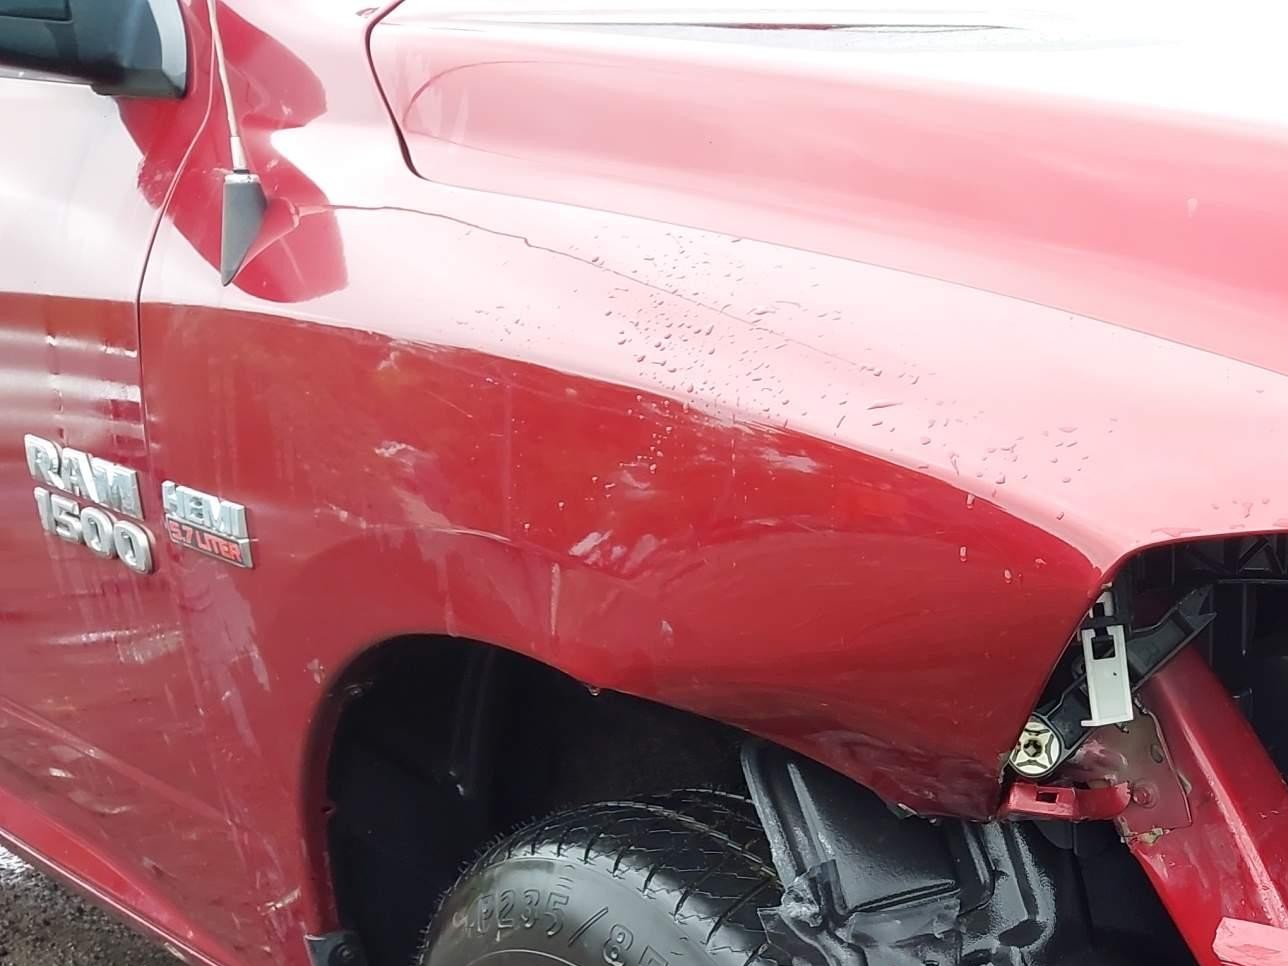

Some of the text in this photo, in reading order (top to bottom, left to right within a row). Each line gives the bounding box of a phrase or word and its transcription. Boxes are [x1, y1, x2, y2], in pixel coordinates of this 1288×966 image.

[24, 433, 145, 521] RAM
[161, 480, 248, 539] HEMI
[34, 486, 155, 575] 1500
[169, 522, 242, 562] 5.7 LITER
